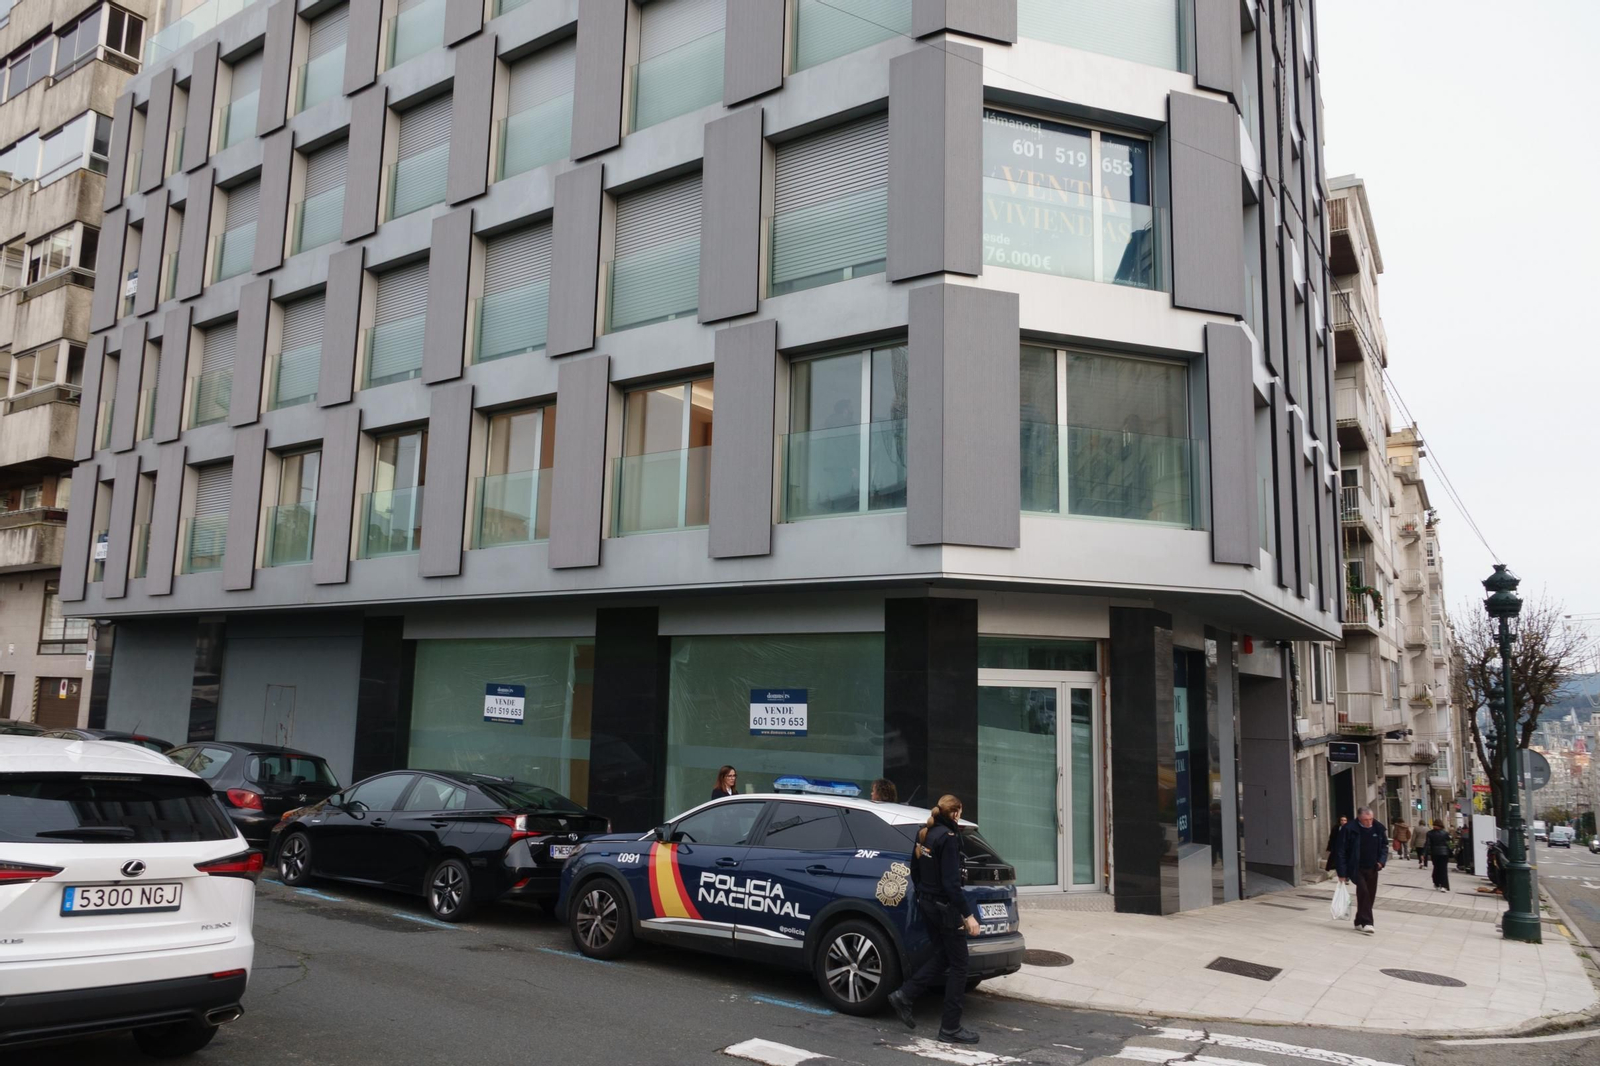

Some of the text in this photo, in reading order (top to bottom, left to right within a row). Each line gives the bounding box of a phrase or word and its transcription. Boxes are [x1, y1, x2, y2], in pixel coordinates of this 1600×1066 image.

[983, 111, 1042, 133] lámanos!
[1012, 139, 1133, 177] 601 519 653
[983, 233, 1011, 245] esde
[984, 245, 1052, 271] 76.000€
[495, 698, 516, 706] VENDE
[764, 706, 795, 715] VENDE
[486, 706, 522, 717] 601 519 653
[752, 716, 805, 727] 601 519 653
[854, 849, 881, 859] 2NF
[699, 871, 786, 899] POLICÍA
[79, 886, 177, 908] 5300 NGJ
[698, 887, 811, 920] NACIONAL
